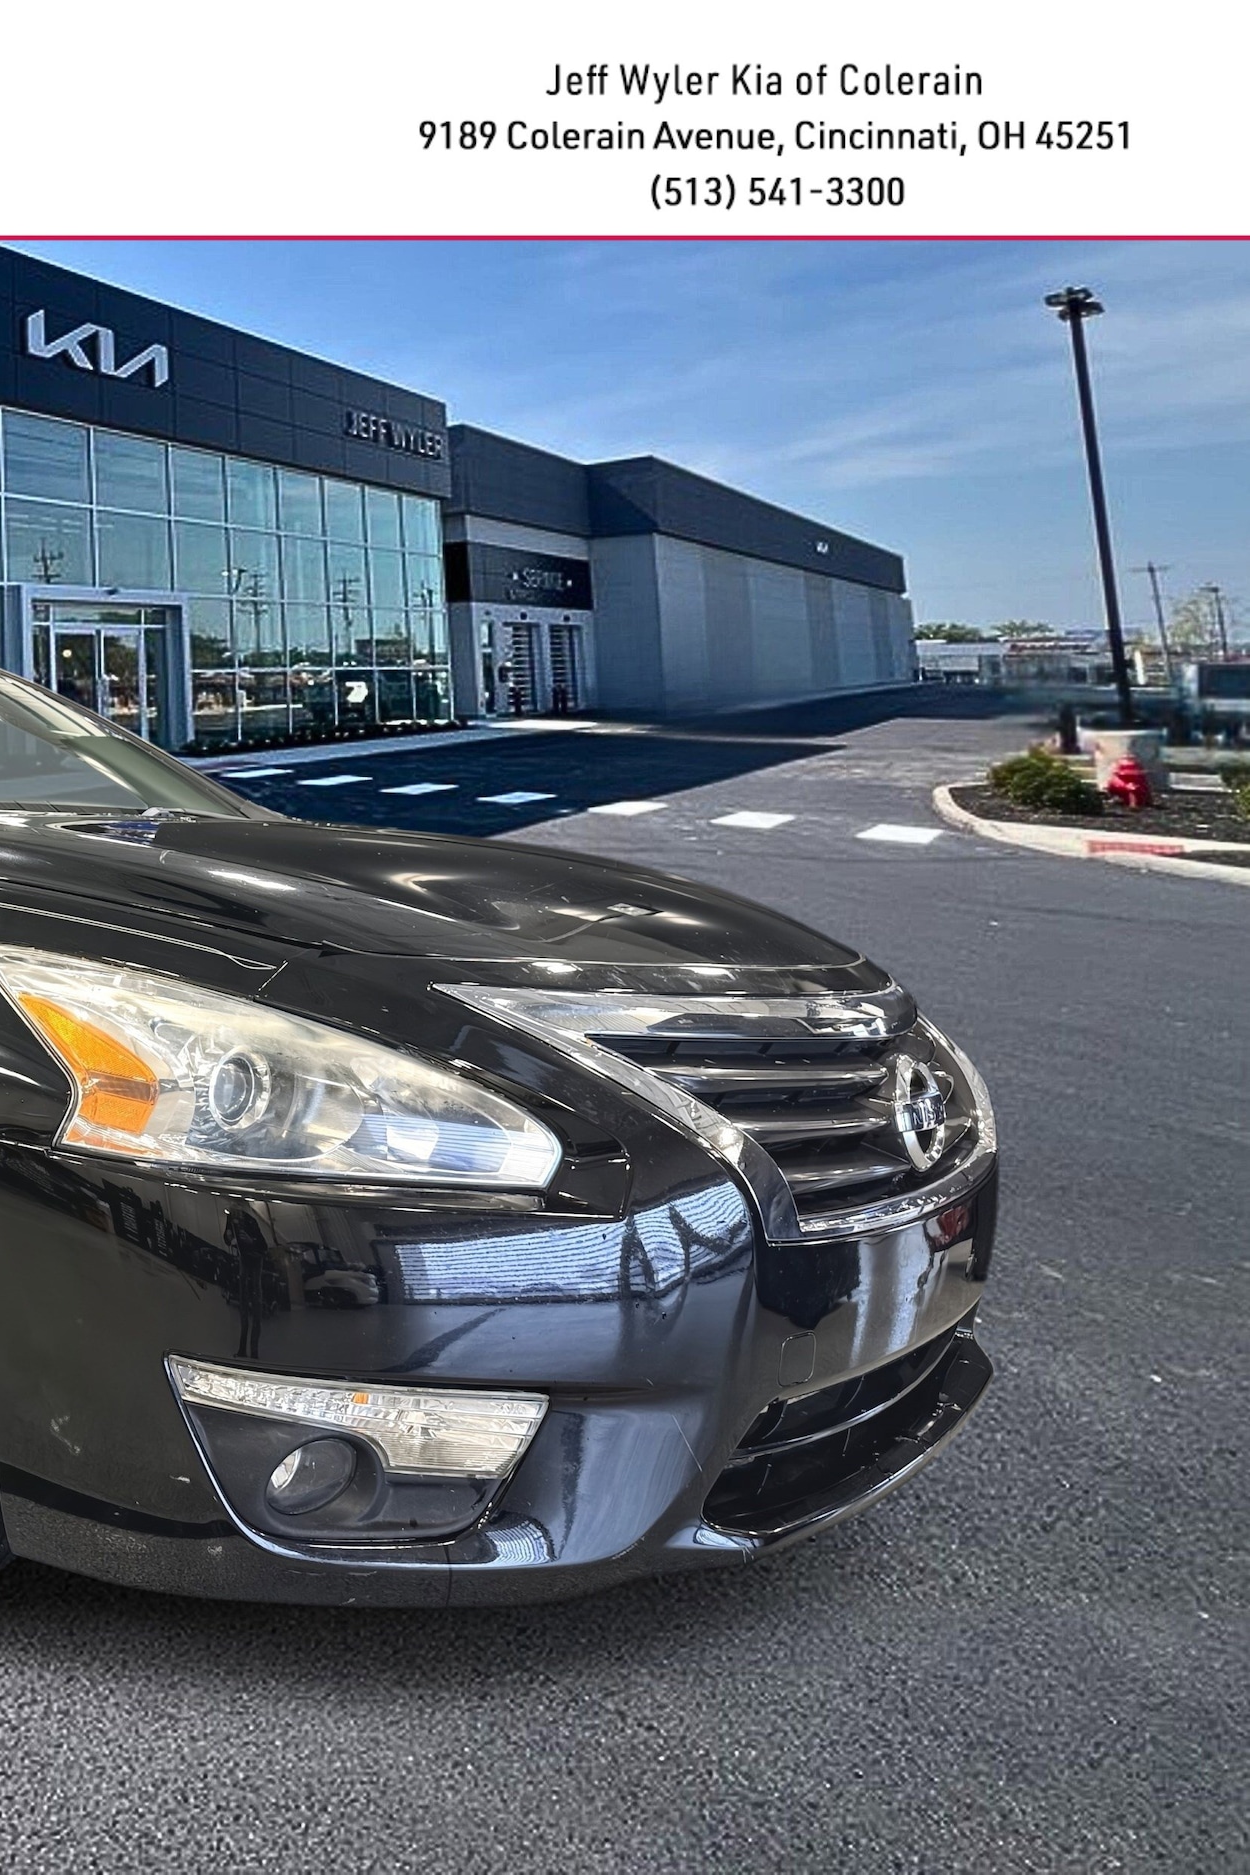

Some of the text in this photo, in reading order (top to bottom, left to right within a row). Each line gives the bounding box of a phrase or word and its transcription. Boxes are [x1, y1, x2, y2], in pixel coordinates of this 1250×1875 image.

[28, 309, 168, 388] KIA
[348, 411, 444, 459] JEFF WYLER
